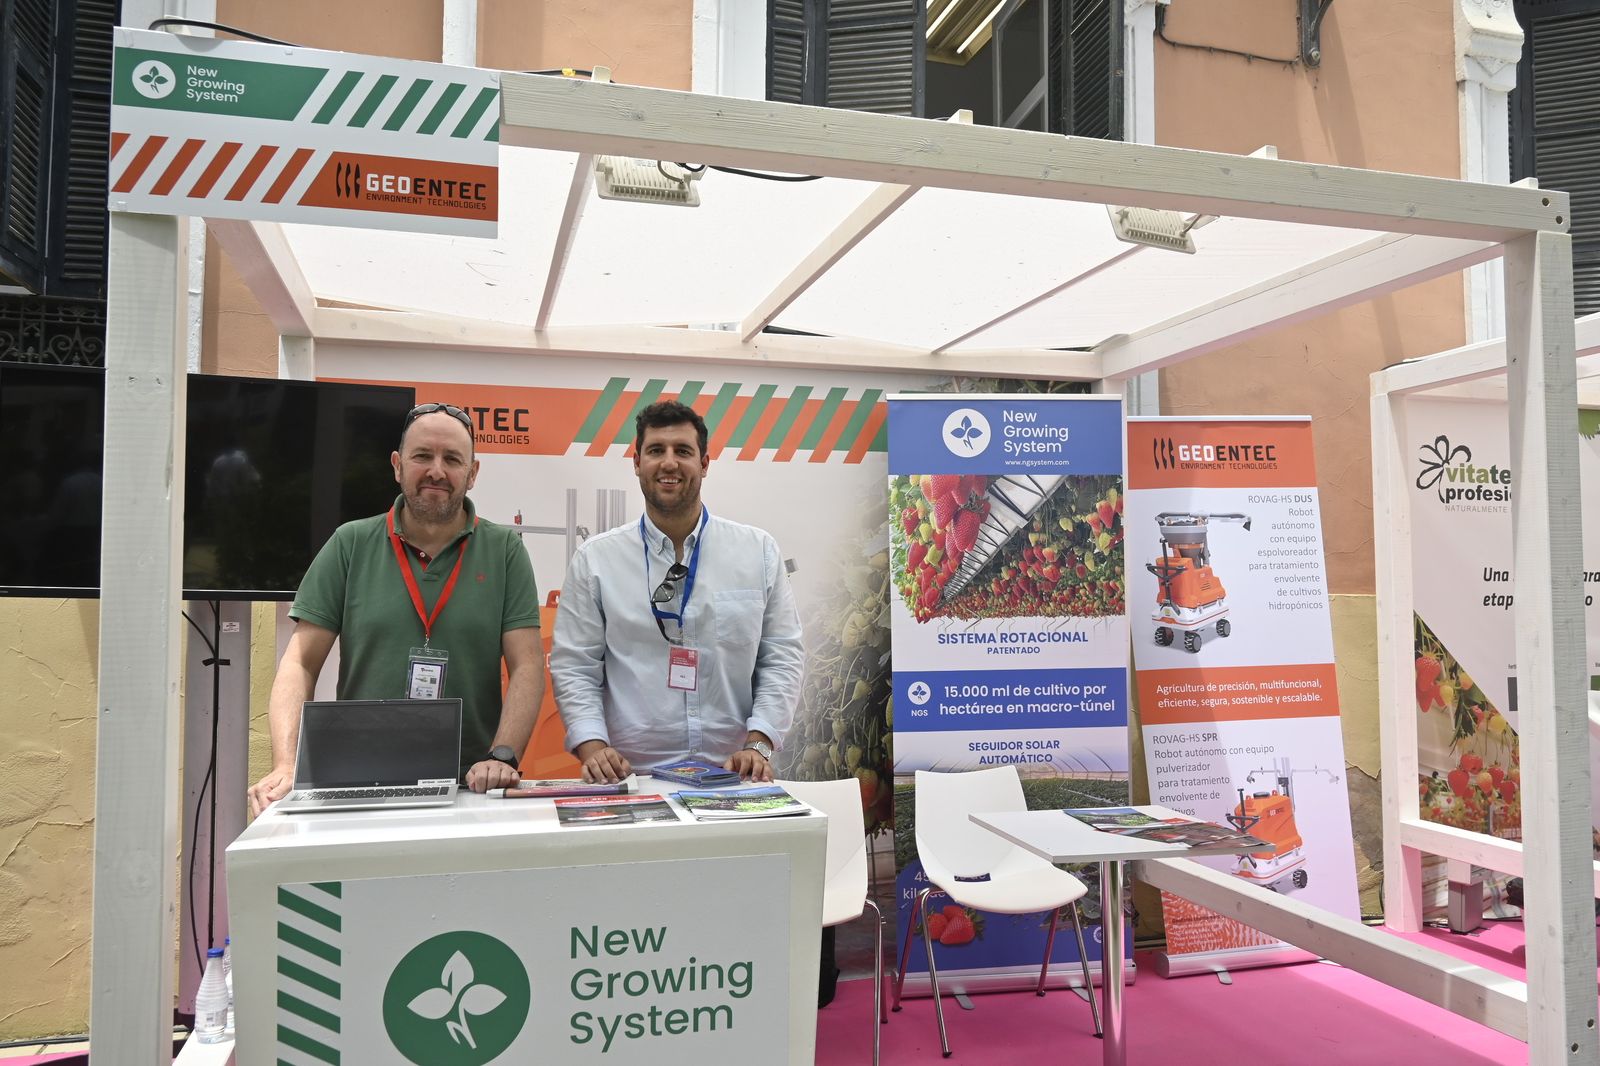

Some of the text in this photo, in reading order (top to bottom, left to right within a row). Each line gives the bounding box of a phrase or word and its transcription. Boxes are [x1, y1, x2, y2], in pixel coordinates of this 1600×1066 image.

[187, 65, 218, 77] New
[187, 77, 245, 95] Growing
[186, 88, 238, 103] System
[366, 173, 487, 201] GEOENTEC
[366, 193, 487, 211] ENVIRONMENT TECHNOLOGIES
[464, 407, 529, 432] TEC
[1003, 410, 1037, 423] New
[1003, 425, 1069, 442] Growing
[1003, 440, 1062, 456] System
[1179, 445, 1277, 461] GEOENTEC
[1005, 458, 1070, 467] www.ngsystem.com
[1181, 462, 1278, 470] ENVIRONMENT TECHNOLOGIES
[1248, 495, 1313, 504] ROVAG-HS DUS
[1445, 485, 1512, 504] profesi
[1288, 508, 1314, 516] Robot
[1445, 505, 1508, 513] NATURALMENTE
[1271, 520, 1315, 530] autónomo
[1287, 534, 1316, 545] equipo
[1257, 548, 1318, 557] espolvoreador
[1249, 561, 1319, 571] para tratamiento
[1274, 574, 1320, 583] envolvente
[1483, 567, 1510, 582] Una
[1277, 587, 1322, 596] de cultivos
[1269, 600, 1323, 610] hidropónicos
[938, 631, 1088, 645] SISTEMA ROTACIONAL
[987, 646, 1041, 655] PATENTADO
[944, 683, 1106, 699] 15.000 ml de cultivo por
[1156, 678, 1322, 695] Agricultura de precisión, multifuncional,
[1158, 693, 1323, 708] eficiente, segura, sostenible y escalable.
[911, 709, 928, 717] NGS
[940, 700, 1115, 715] hectárea en macro-túnel
[1152, 732, 1218, 745] ROVAG-HS SPR
[968, 740, 1060, 751] SEGUIDOR SOLAR
[1154, 744, 1275, 759] Robot autónomo con equipo
[979, 752, 1053, 765] AUTOMÁTICO
[1156, 763, 1211, 775] pulverizador
[1158, 776, 1230, 790] para tratamiento
[1159, 790, 1220, 803] envolvente de
[570, 925, 667, 959] New
[570, 956, 753, 1001] Growing
[570, 1004, 733, 1053] System
